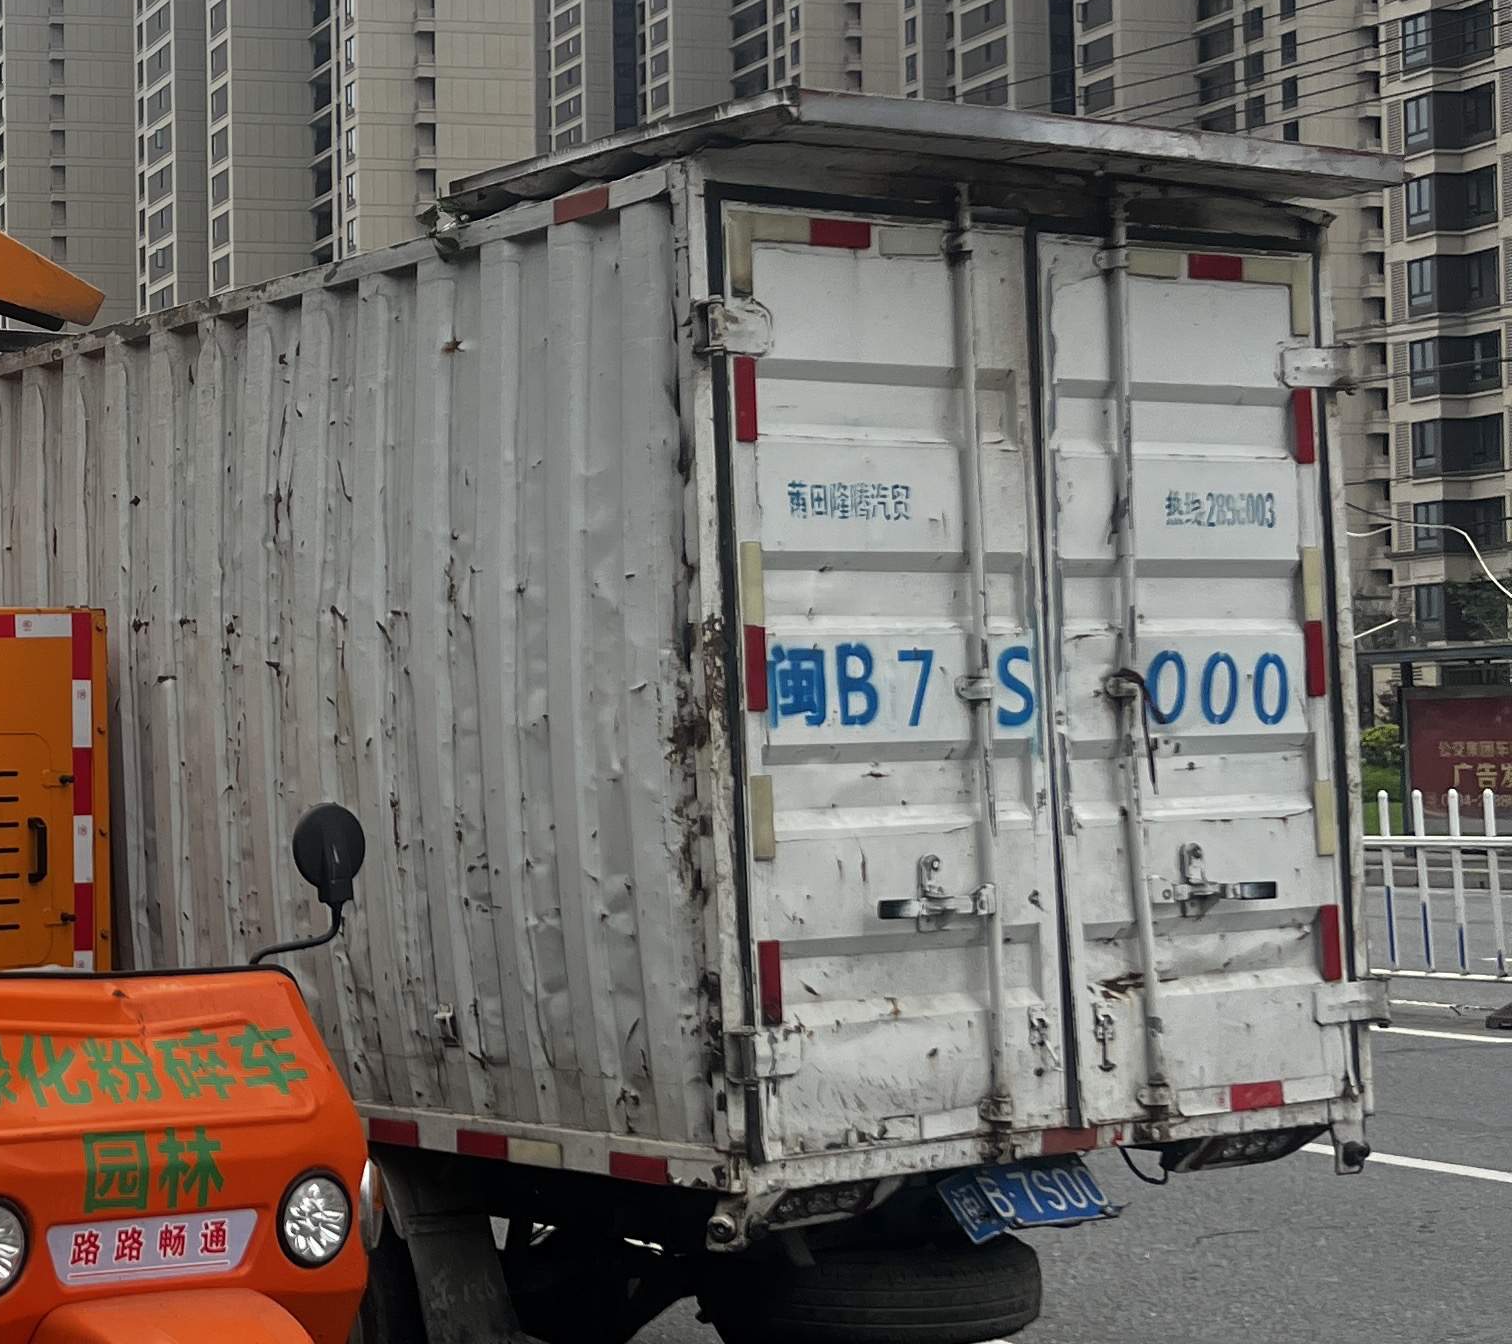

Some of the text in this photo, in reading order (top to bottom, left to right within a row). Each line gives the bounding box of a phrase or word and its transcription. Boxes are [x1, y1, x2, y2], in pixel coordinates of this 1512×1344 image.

[1438, 740, 1512, 757] 公交集团车
[83, 1125, 225, 1213] 园林
[70, 1218, 229, 1267] 路路畅通
